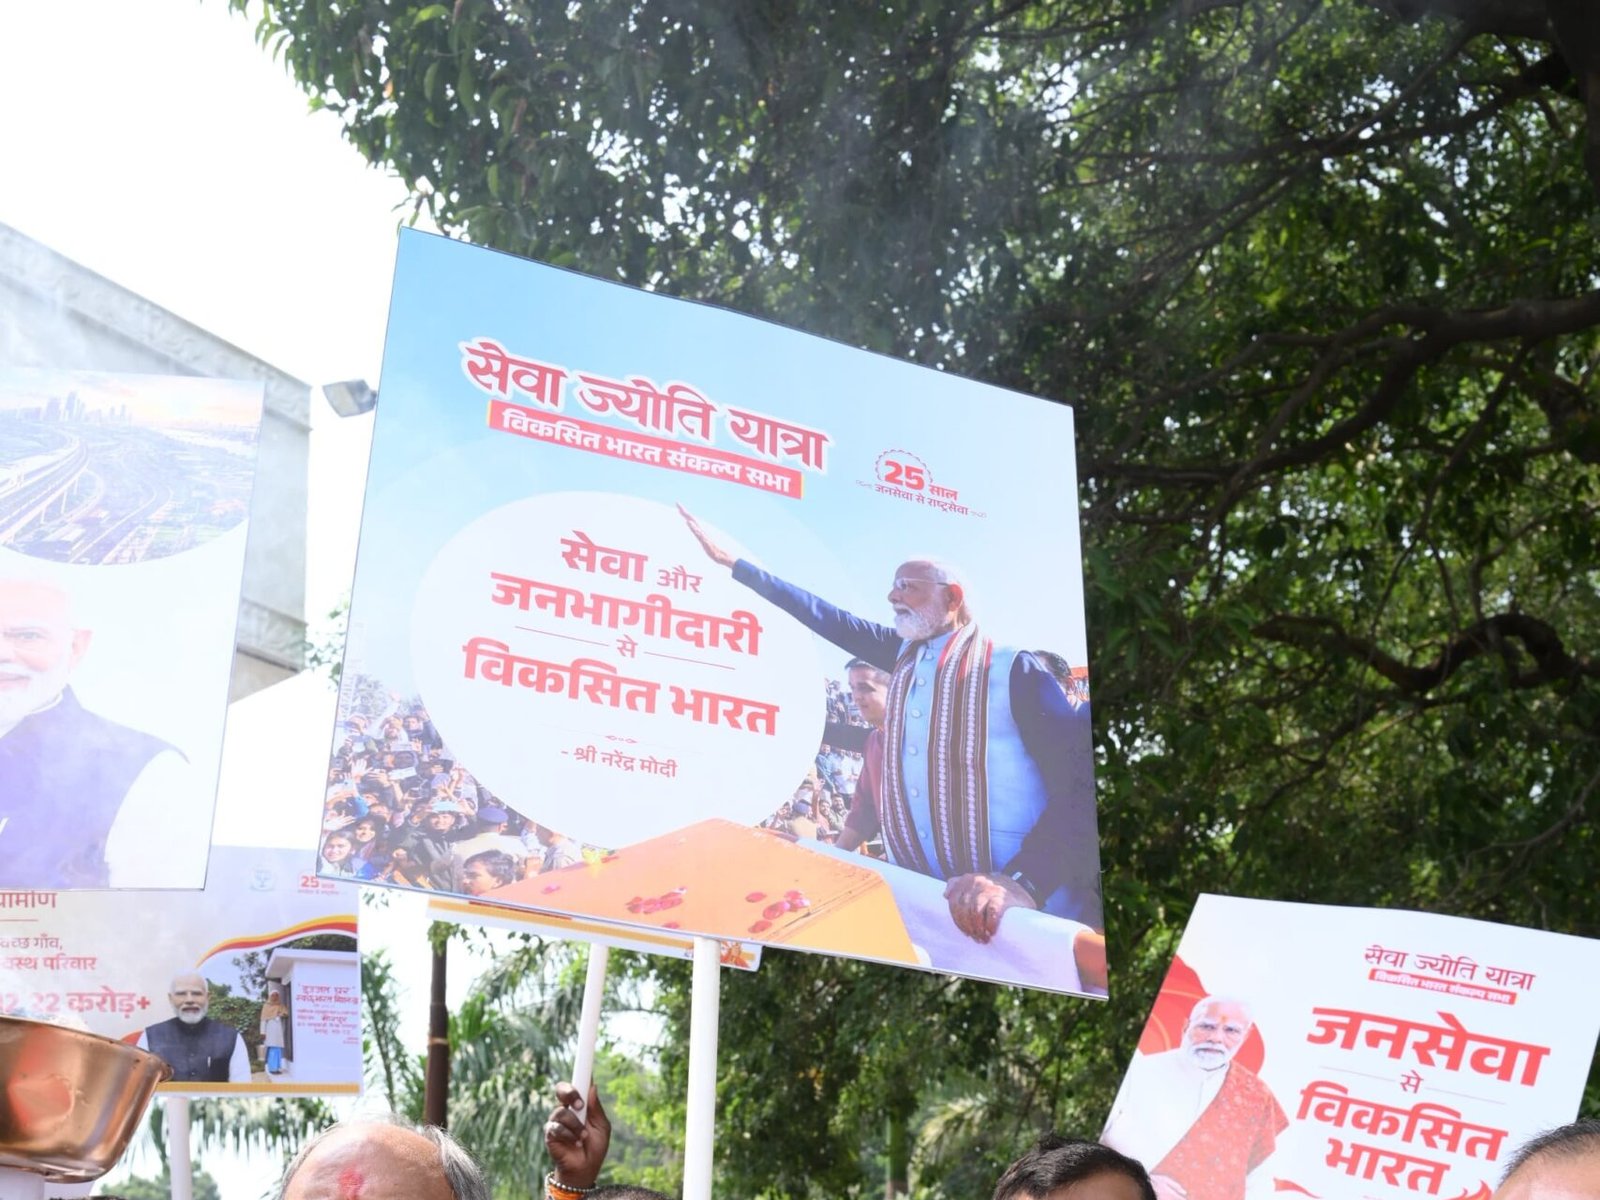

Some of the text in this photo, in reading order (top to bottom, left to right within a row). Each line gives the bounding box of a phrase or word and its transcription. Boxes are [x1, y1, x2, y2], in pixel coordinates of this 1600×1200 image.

[464, 341, 829, 470] सेवा ज्योति यात्रा
[502, 408, 791, 493] विकसित भारत संकल्प सभा
[884, 460, 925, 490] 25
[929, 483, 958, 501] साल
[875, 483, 969, 515] जनसेवा से राष्ट्रसेवा
[560, 530, 703, 593] सेवा और
[491, 571, 763, 656] जनभागीदारी
[616, 634, 638, 658] से
[462, 636, 780, 736] विकसित भारत
[574, 745, 597, 764] श्री
[600, 749, 636, 772] नरेंद्र
[639, 755, 678, 778] मोदी
[301, 875, 320, 888] 25
[42, 952, 98, 971] परिवार
[1365, 945, 1536, 990] सेवा ज्योति यात्रा
[1306, 1007, 1551, 1087] जनसेवा
[1399, 1070, 1424, 1093] से
[1296, 1080, 1509, 1162] विकसित
[1325, 1138, 1451, 1196] भारत
